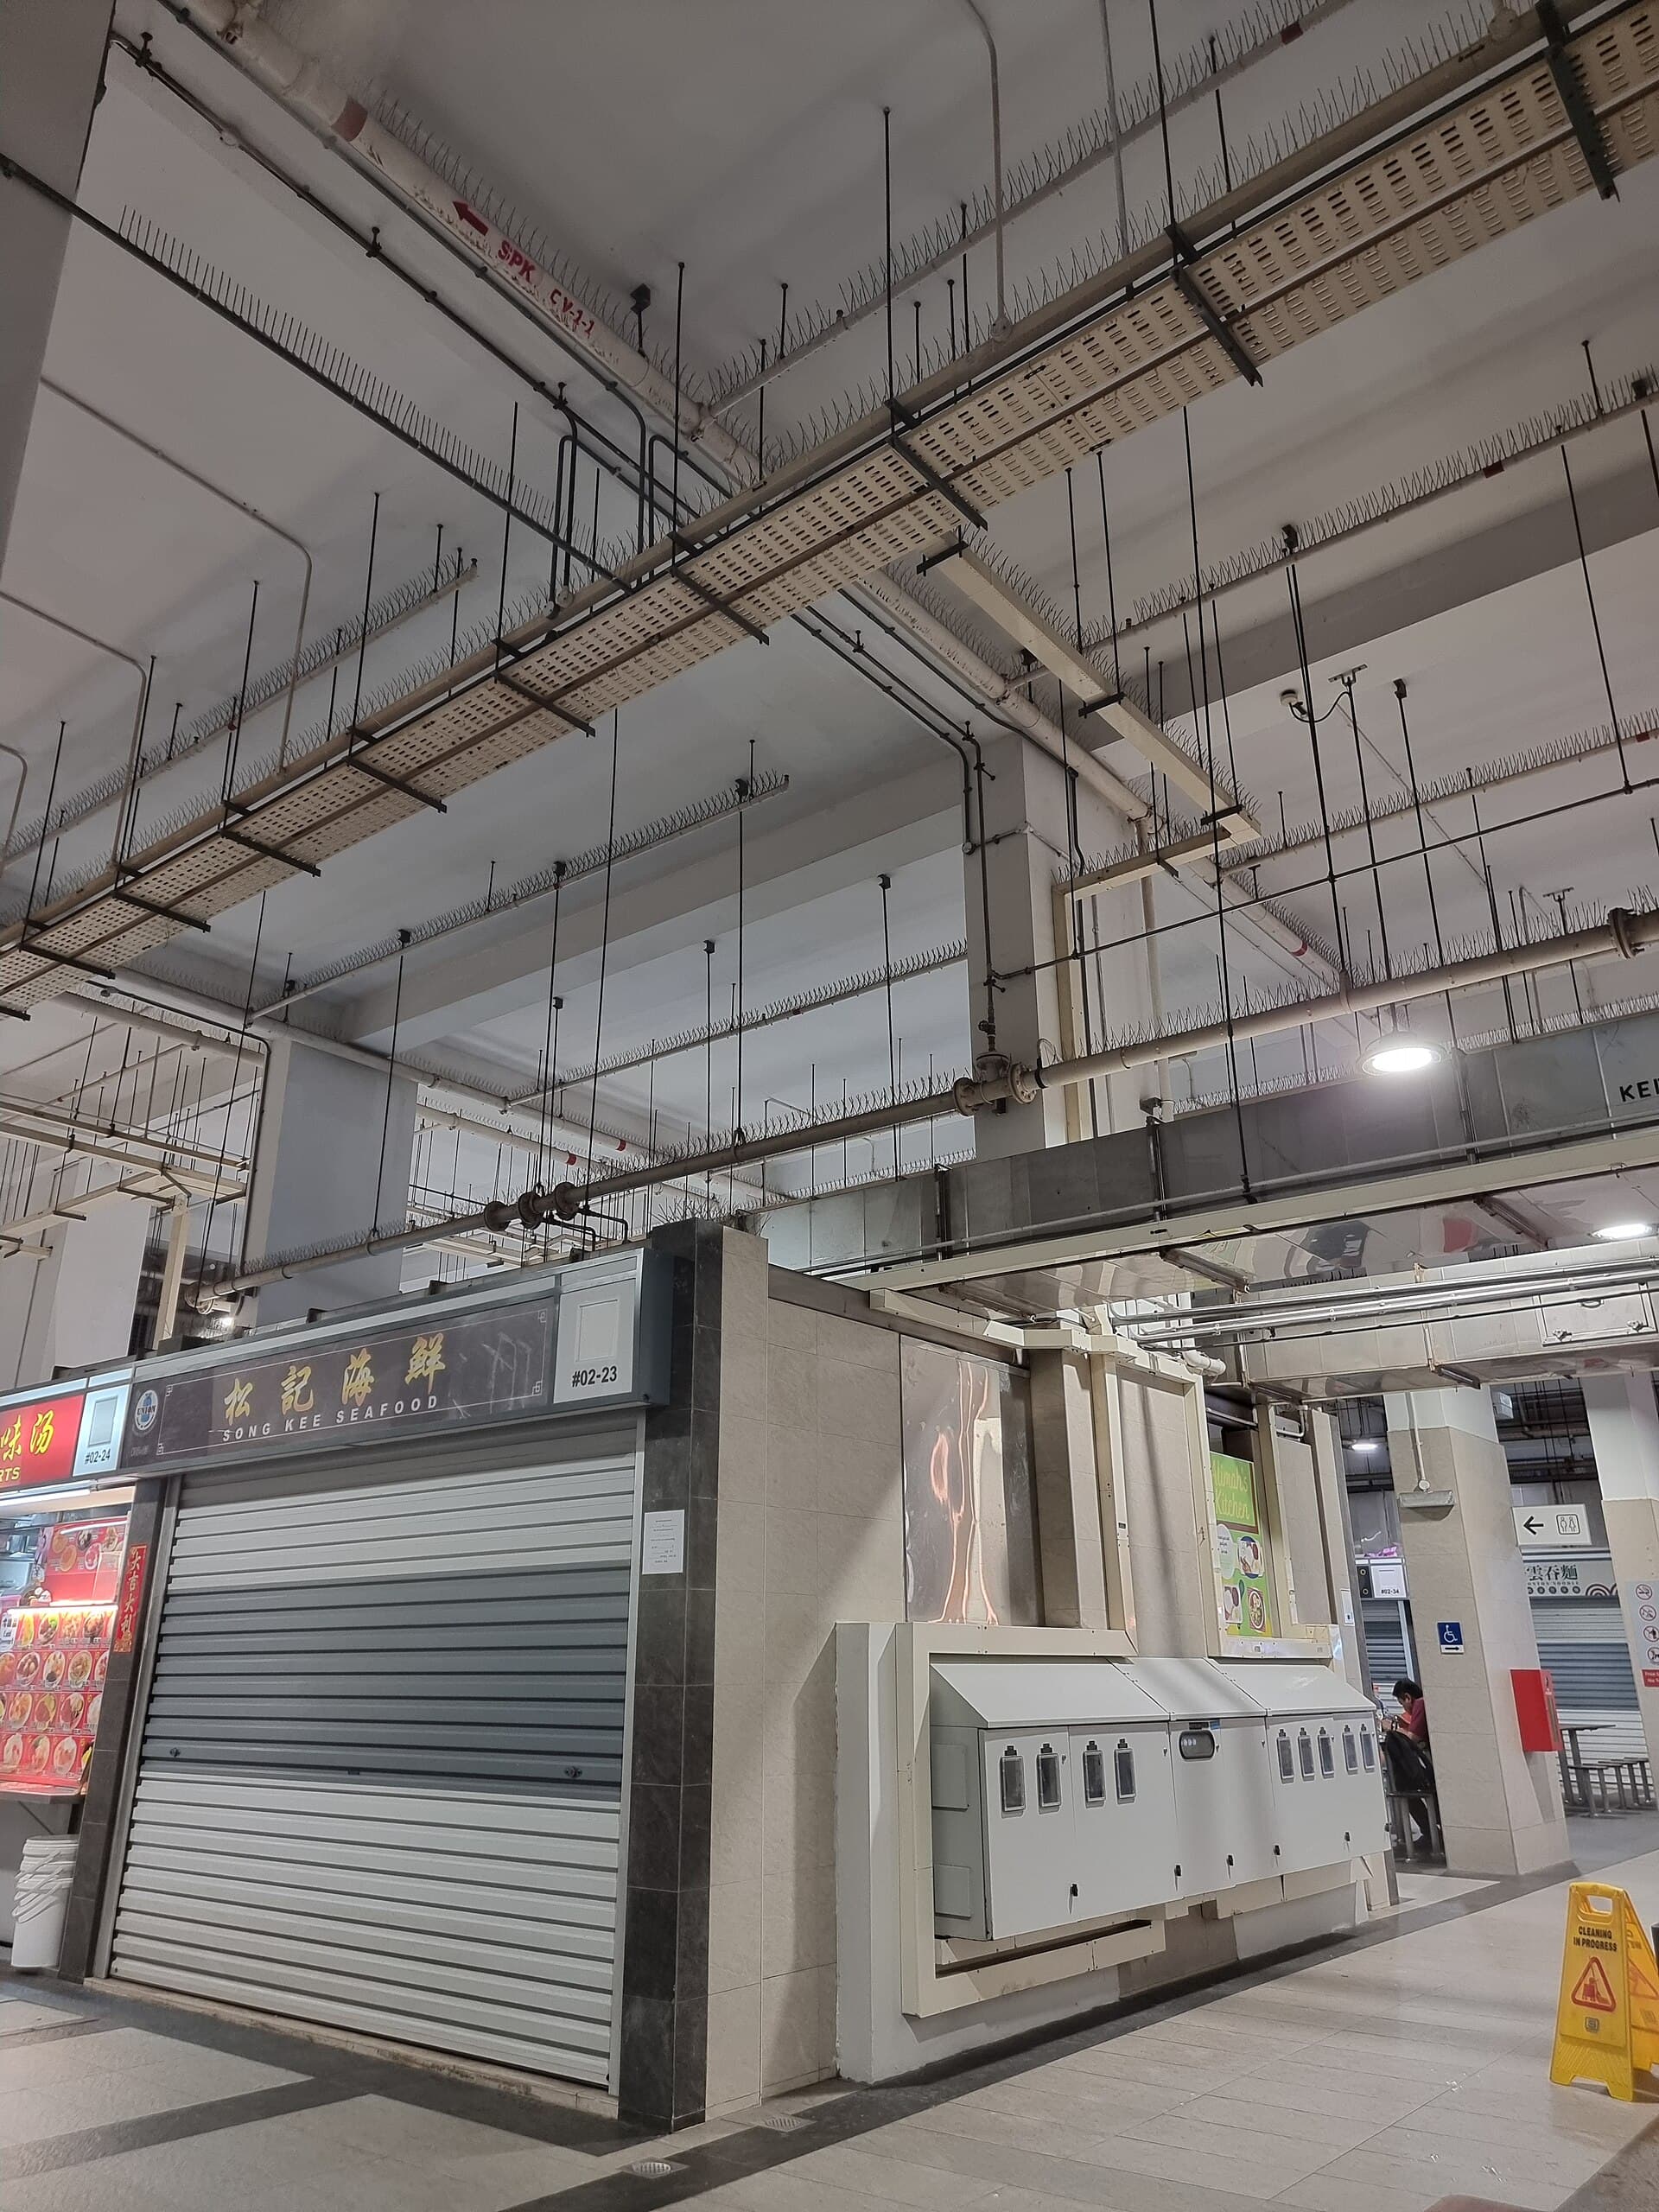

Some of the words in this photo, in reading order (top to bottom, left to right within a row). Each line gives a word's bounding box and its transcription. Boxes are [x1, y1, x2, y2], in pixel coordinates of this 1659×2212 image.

[498, 239, 536, 283] SPK
[224, 1332, 446, 1426] 松記海鮮
[572, 1365, 617, 1388] #02-23
[222, 1422, 270, 1442] SONG
[285, 1414, 321, 1432] KEE
[336, 1395, 438, 1424] SEAFOOD
[84, 1449, 111, 1465] #02-24
[1573, 1936, 1580, 1947] IN
[1582, 1938, 1618, 1952] PROGRESS
[1578, 1926, 1612, 1940] CLEANING
